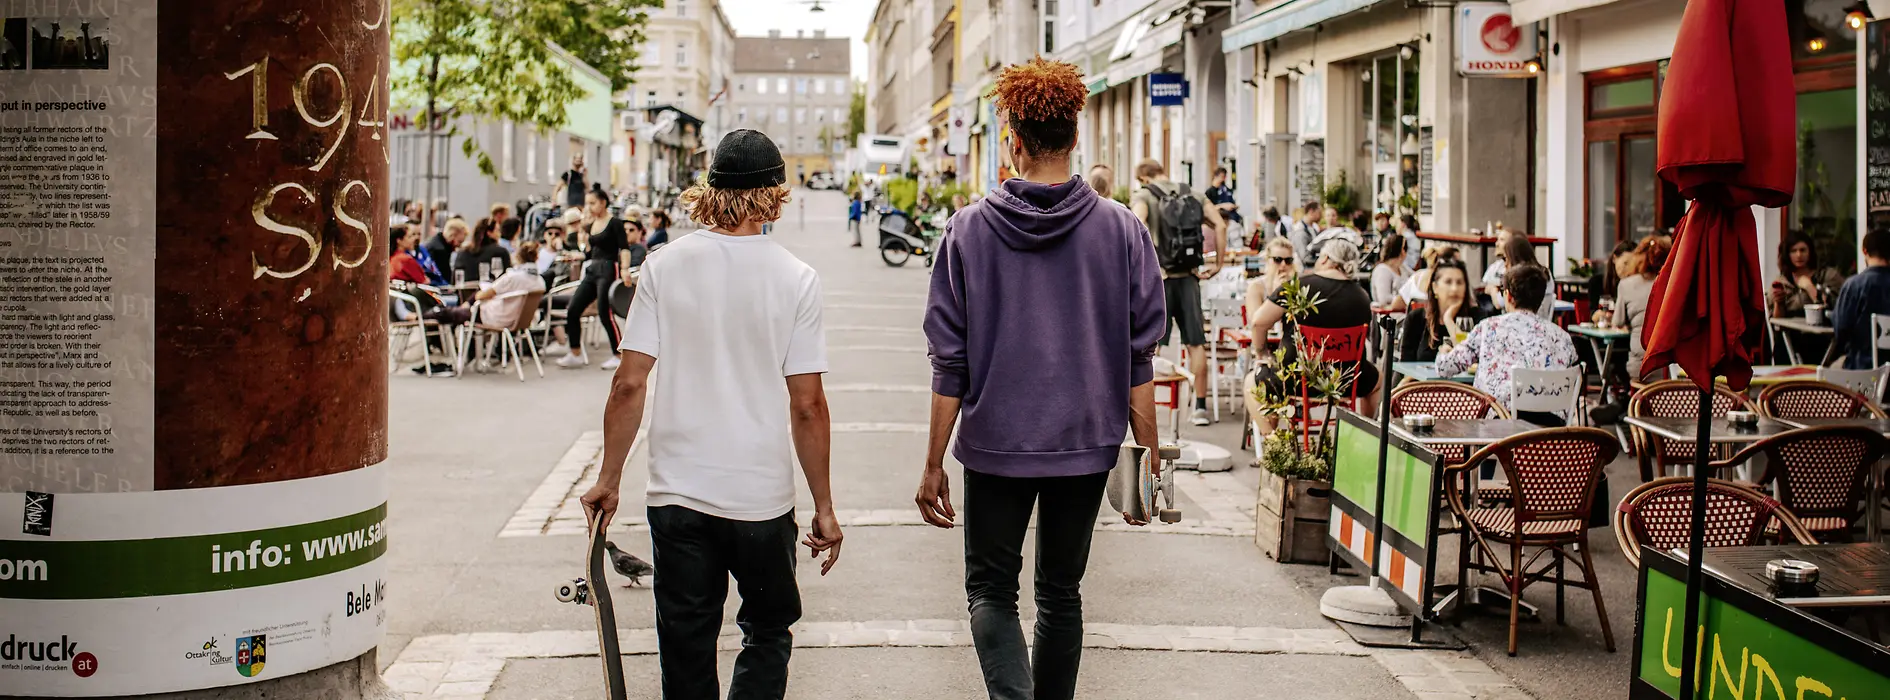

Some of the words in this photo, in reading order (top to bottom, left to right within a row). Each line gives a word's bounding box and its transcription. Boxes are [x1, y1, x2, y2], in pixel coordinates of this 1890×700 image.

[1, 100, 18, 112] put
[22, 100, 31, 110] in
[35, 100, 106, 112] perspective
[70, 165, 94, 173] plaque
[74, 193, 111, 201] represent-
[251, 179, 374, 281] SS
[56, 362, 73, 370] lively
[212, 540, 291, 573] info:
[0, 558, 48, 580] om
[346, 584, 371, 617] Bele
[0, 634, 78, 662] druck
[78, 660, 92, 670] at
